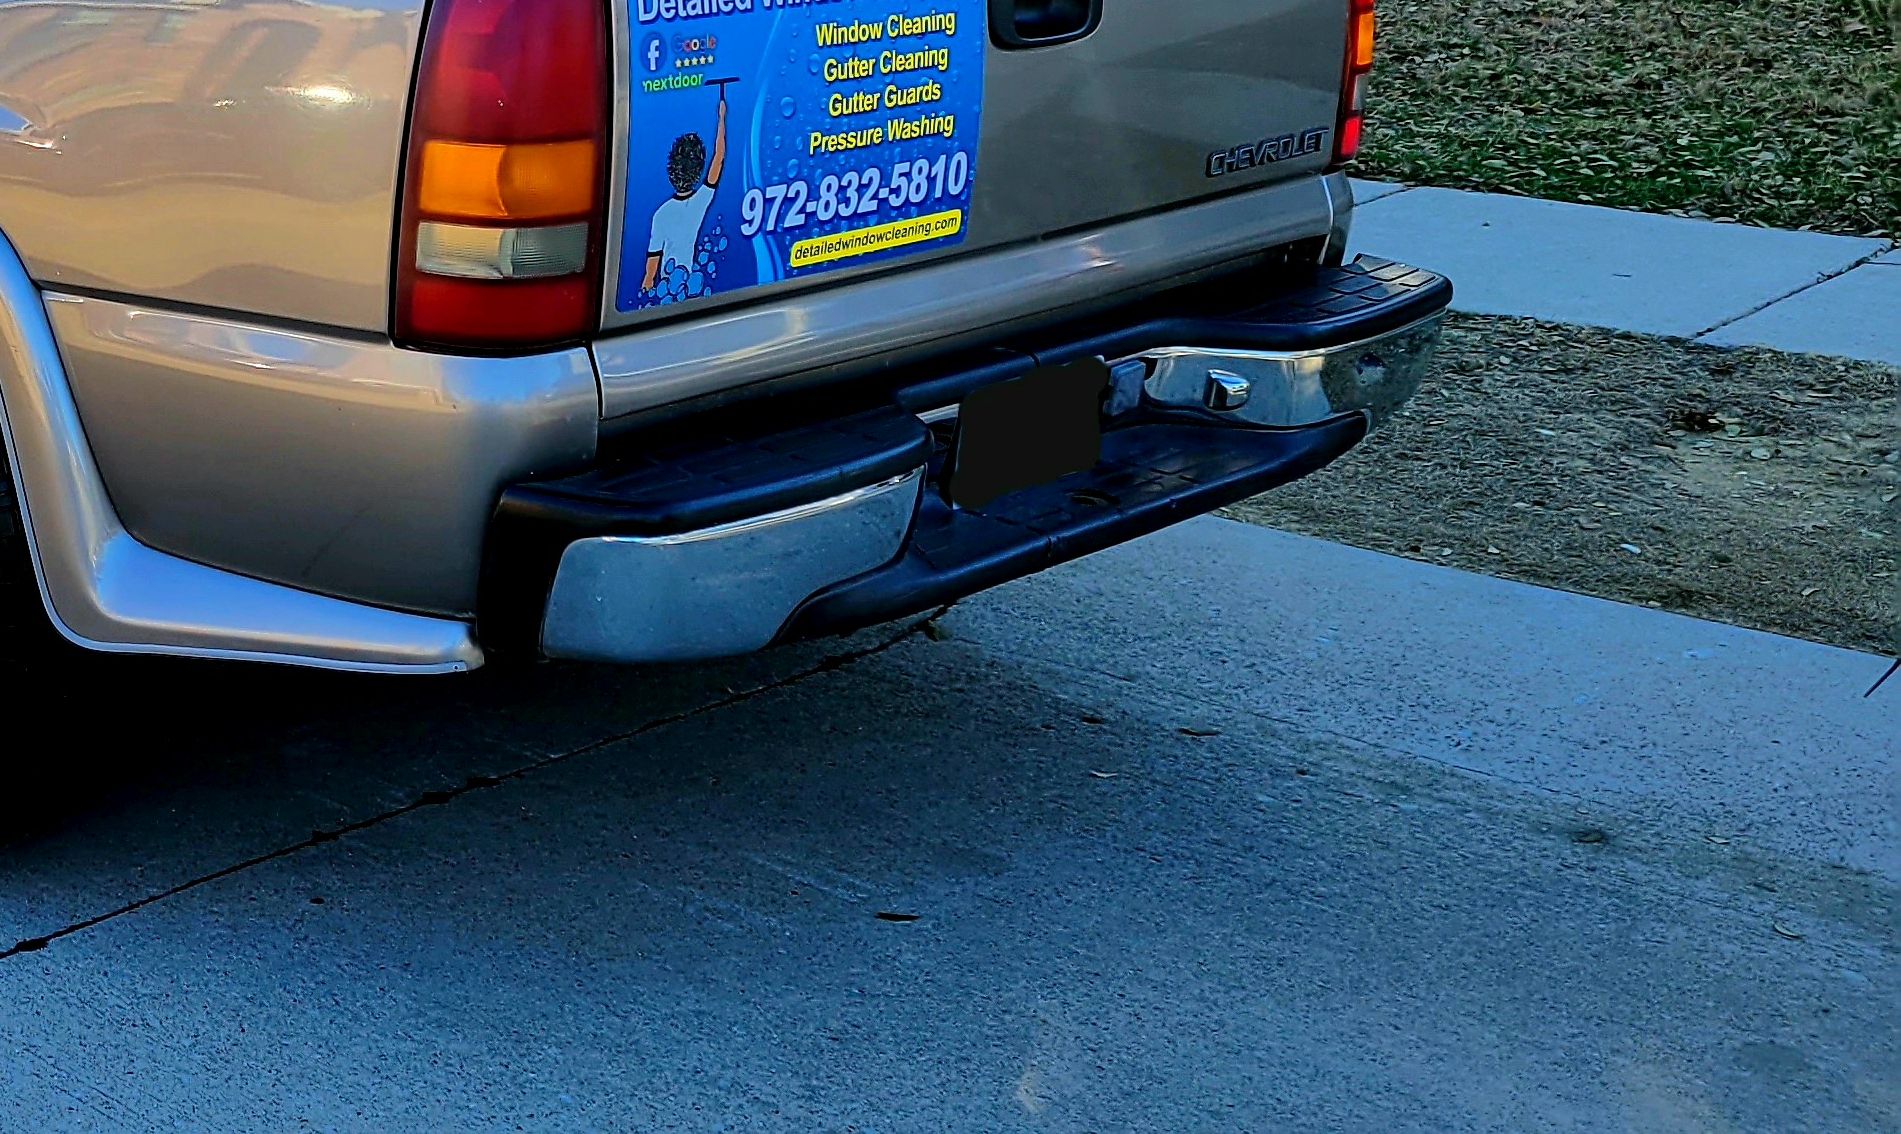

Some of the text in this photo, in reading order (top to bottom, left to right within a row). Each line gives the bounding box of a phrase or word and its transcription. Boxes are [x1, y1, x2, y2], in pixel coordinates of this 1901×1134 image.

[670, 32, 717, 54] Google
[815, 9, 957, 48] Window Cleaning
[642, 72, 704, 93] nextdoor
[823, 45, 949, 84] Gutter Cleaning
[828, 79, 942, 118] Gutter Guards
[808, 112, 955, 156] Pressure Washing
[1206, 126, 1330, 178] CHEVROLET
[740, 150, 968, 237] 972-832-5810
[794, 215, 958, 262] detailedwindowcleaning.com
